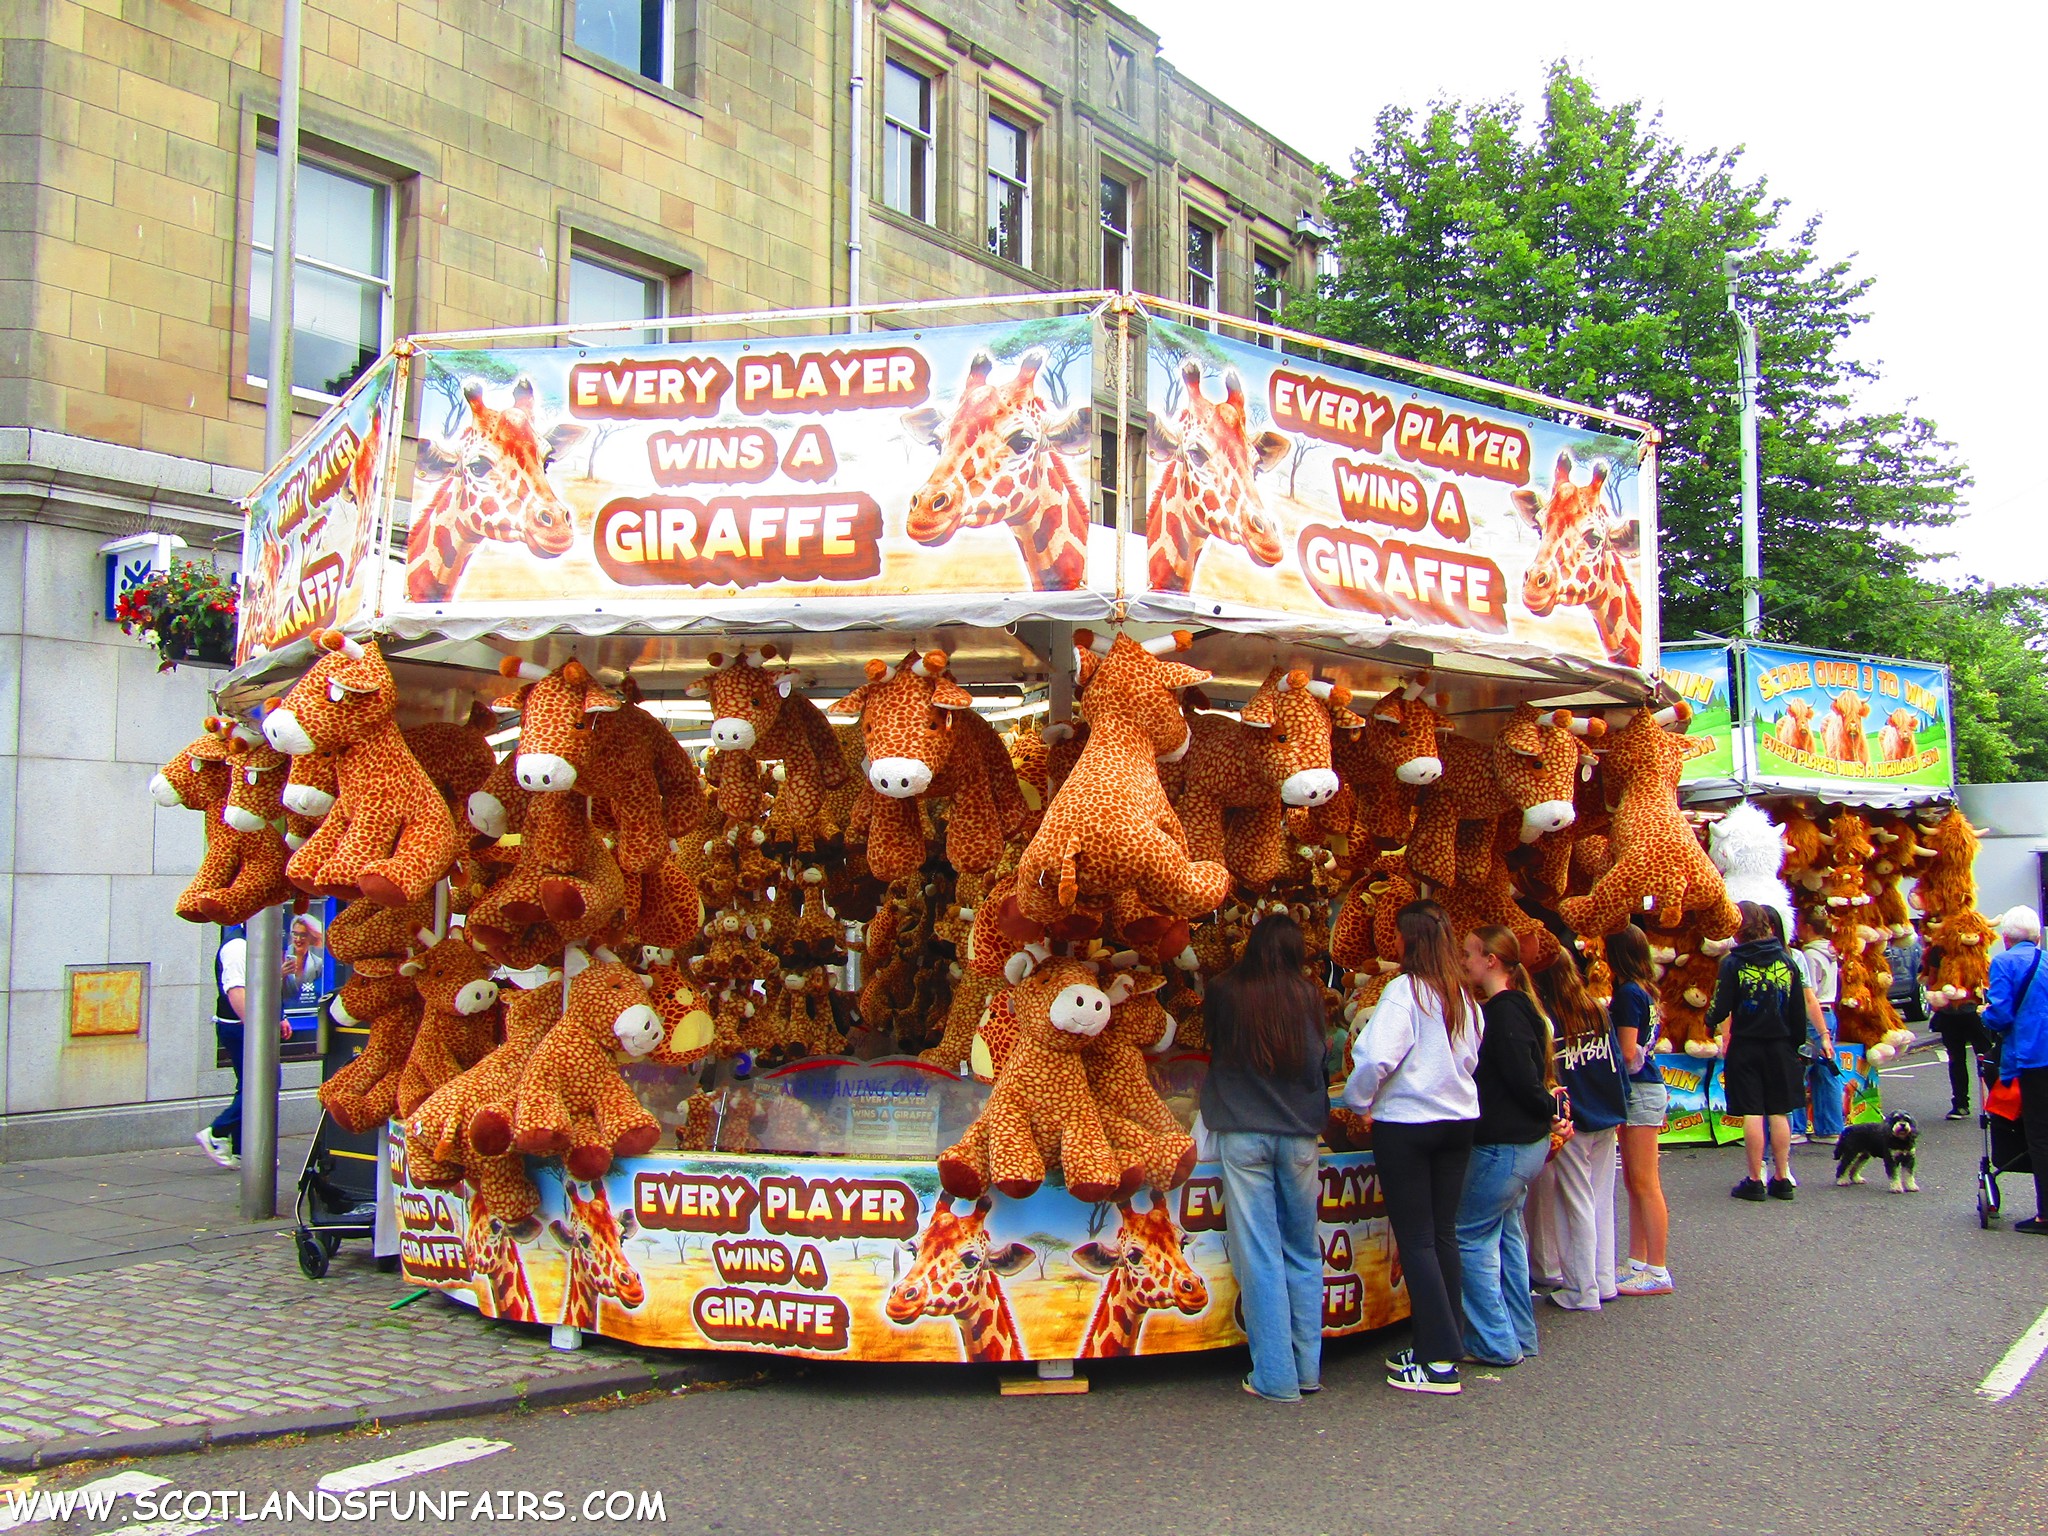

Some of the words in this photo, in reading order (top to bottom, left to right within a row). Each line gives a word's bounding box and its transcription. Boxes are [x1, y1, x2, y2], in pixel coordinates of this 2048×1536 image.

[577, 366, 717, 406] EVERY
[744, 355, 916, 400] PLAYER
[1275, 379, 1386, 438] EVERY
[1401, 412, 1522, 471] PLAYER
[308, 429, 357, 497] PLAYER
[656, 435, 766, 471] WINS
[790, 432, 824, 468] A
[1338, 466, 1419, 516] WINS
[1437, 490, 1460, 524] A
[604, 503, 860, 563] GIRAFFE
[1306, 536, 1491, 613] GIRAFFE
[1757, 662, 1811, 700] SCORE
[1814, 660, 1859, 688] OVER
[1863, 666, 1873, 691] 3
[1877, 670, 1899, 698] TO
[1904, 680, 1937, 717] WIN
[1762, 733, 1798, 763] EVERY
[1798, 749, 1838, 775] PLAYER
[1837, 759, 1865, 778] WINS
[1866, 762, 1875, 778] A
[1877, 757, 1919, 778] HIGHLAND
[1920, 747, 1940, 769] COW
[1660, 1065, 1701, 1092] WIN
[1840, 1051, 1853, 1071] TO
[852, 1108, 877, 1118] WINS
[881, 1110, 888, 1118] A
[894, 1110, 933, 1120] GIRAFFE
[860, 1096, 888, 1104] EVERY
[892, 1096, 926, 1105] PLAYER
[1673, 1112, 1704, 1131] COW
[401, 1197, 430, 1221] WINS
[438, 1201, 449, 1221] A
[641, 1181, 745, 1218] EVERY
[767, 1186, 906, 1222] PLAYER
[401, 1238, 467, 1269] GIRAFFE
[718, 1246, 786, 1274] WINS
[799, 1251, 818, 1276] A
[1332, 1236, 1348, 1260] A
[700, 1296, 835, 1335] GIRAFFE
